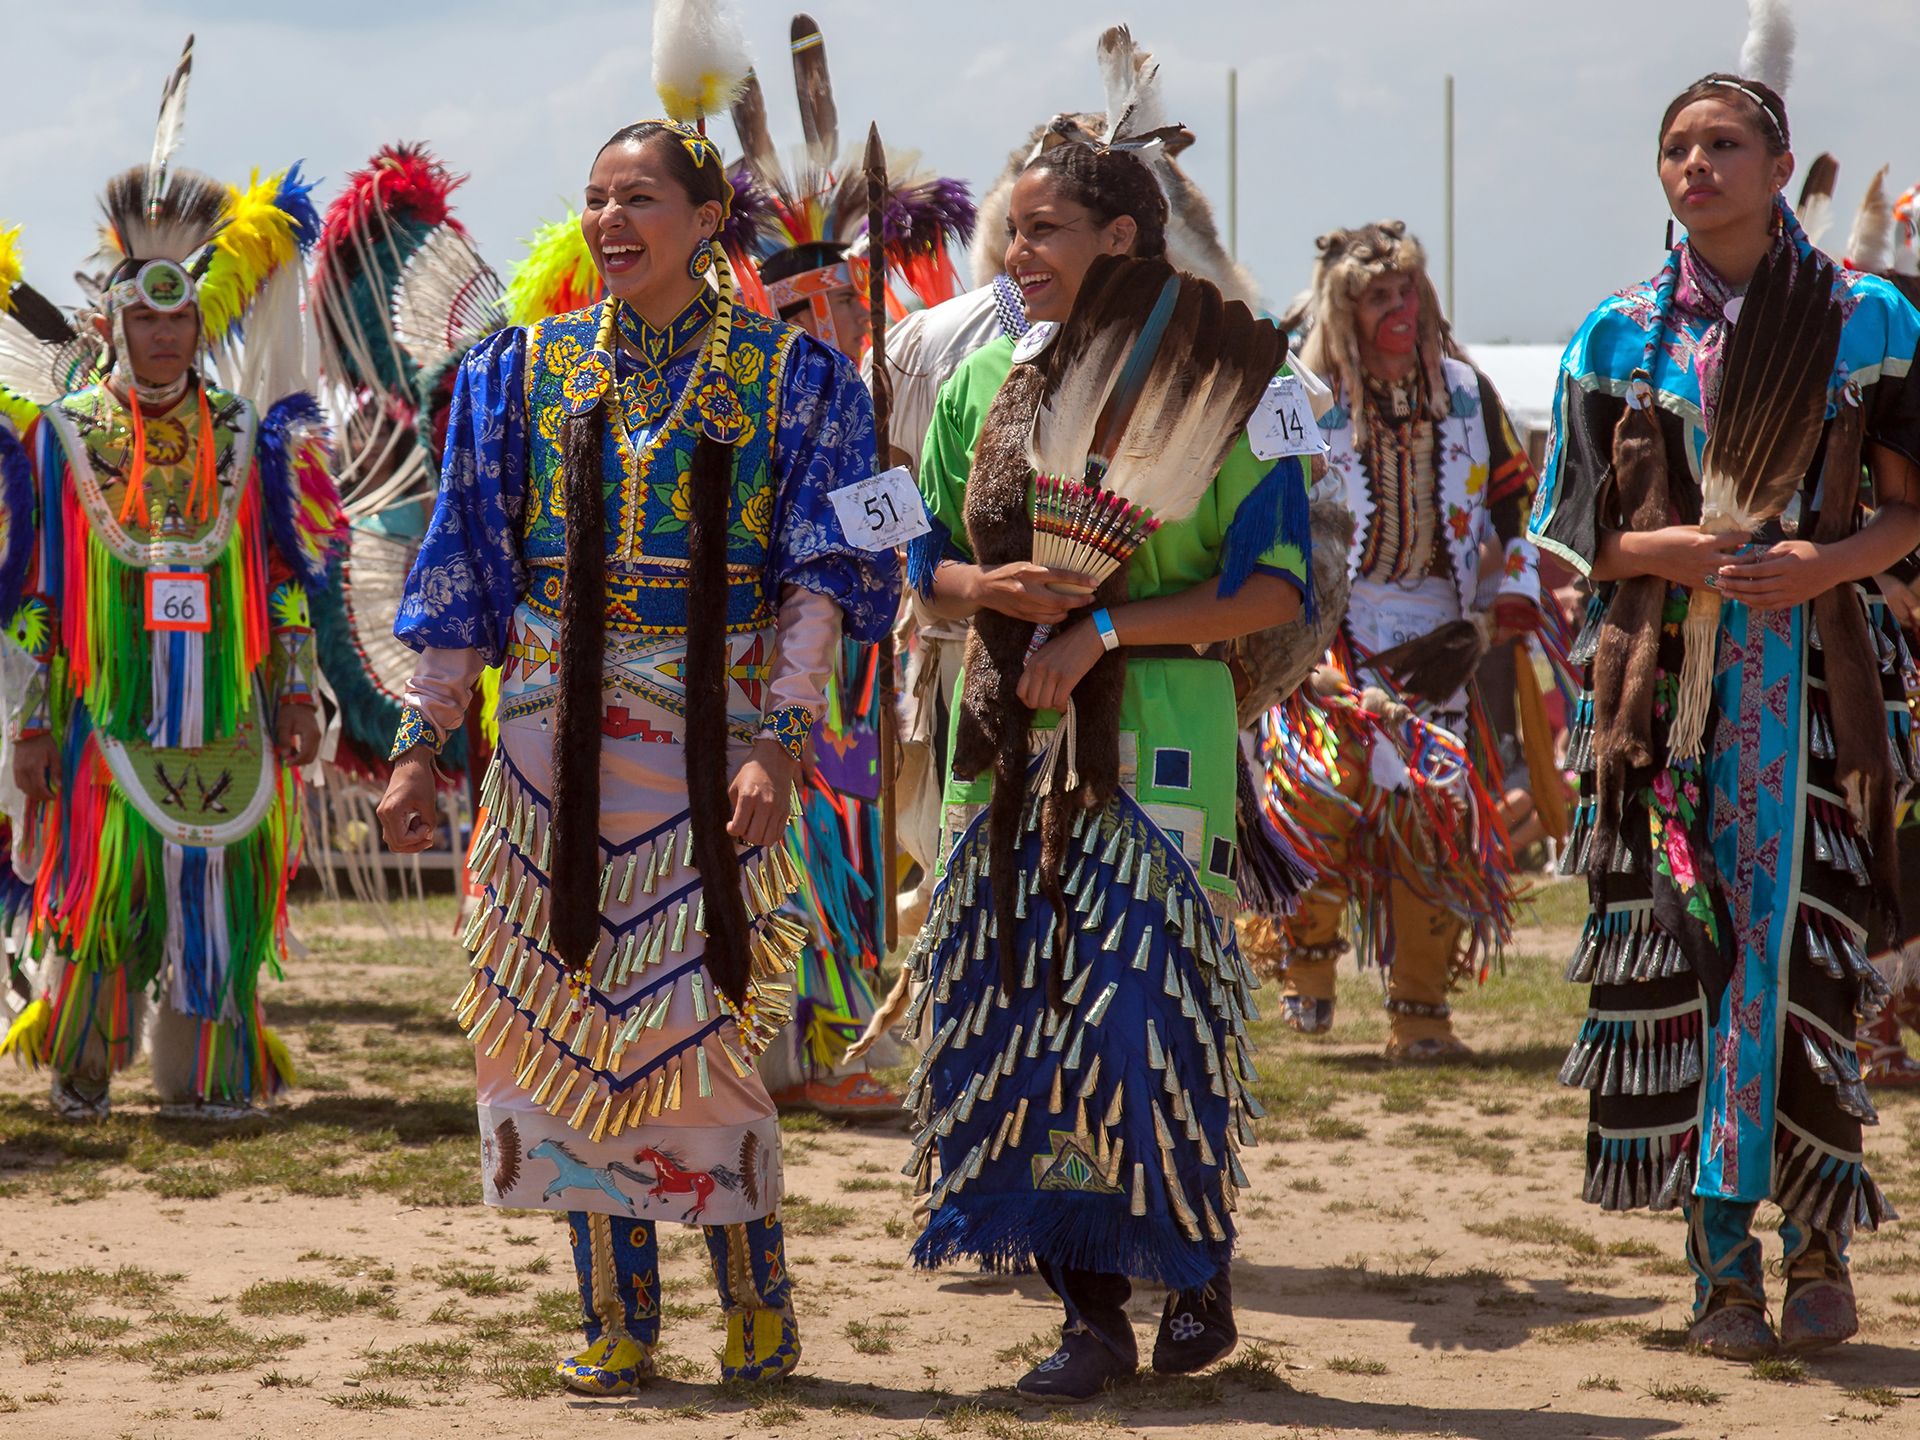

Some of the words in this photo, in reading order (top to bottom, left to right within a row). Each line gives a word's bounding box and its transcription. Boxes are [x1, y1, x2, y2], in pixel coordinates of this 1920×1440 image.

[1275, 408, 1304, 440] 14
[863, 492, 900, 531] 51
[164, 595, 195, 619] 66
